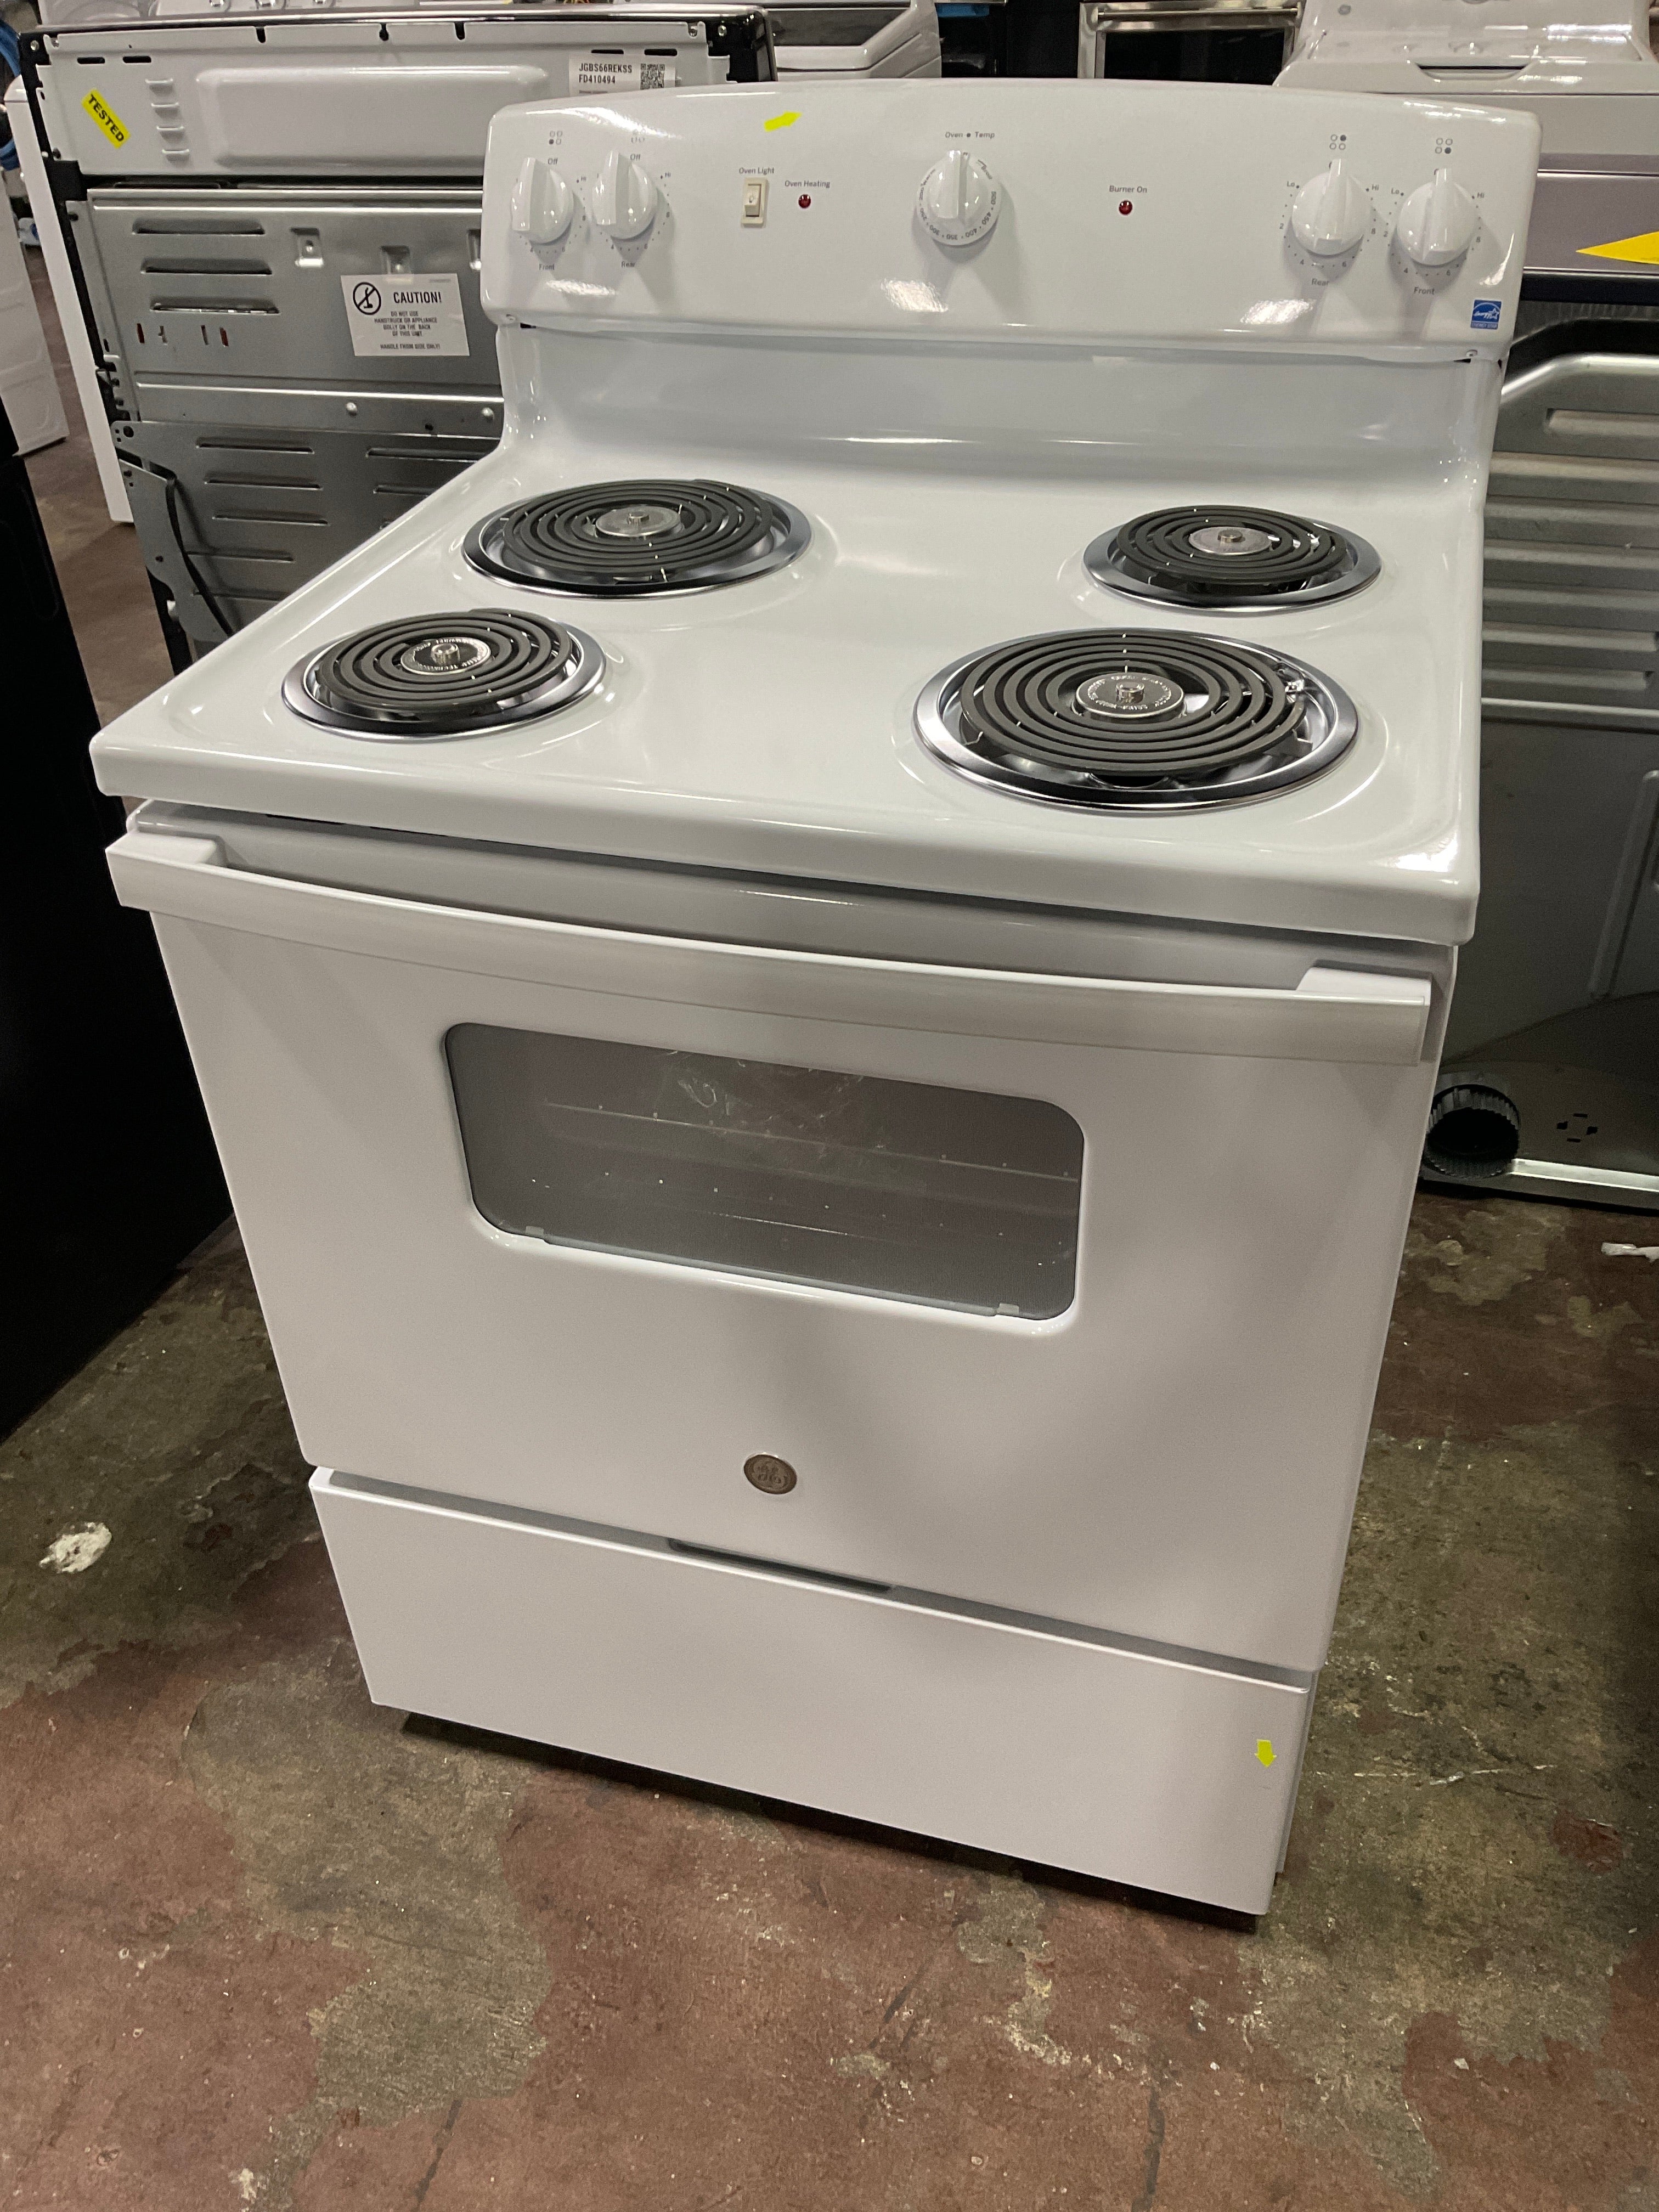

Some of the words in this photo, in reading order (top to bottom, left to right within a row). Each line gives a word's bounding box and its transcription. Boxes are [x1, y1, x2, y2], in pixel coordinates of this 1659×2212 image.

[579, 63, 632, 74] JGBS66REKSS
[579, 74, 616, 84] FD410494
[89, 94, 124, 142] TESTED
[758, 167, 775, 176] Light
[804, 180, 831, 189] Heating
[981, 212, 991, 225] 450
[929, 225, 940, 235] 300
[966, 228, 977, 238] 400
[1311, 278, 1330, 286] Rear
[1414, 286, 1435, 295] Front
[393, 291, 442, 303] CAUTION!
